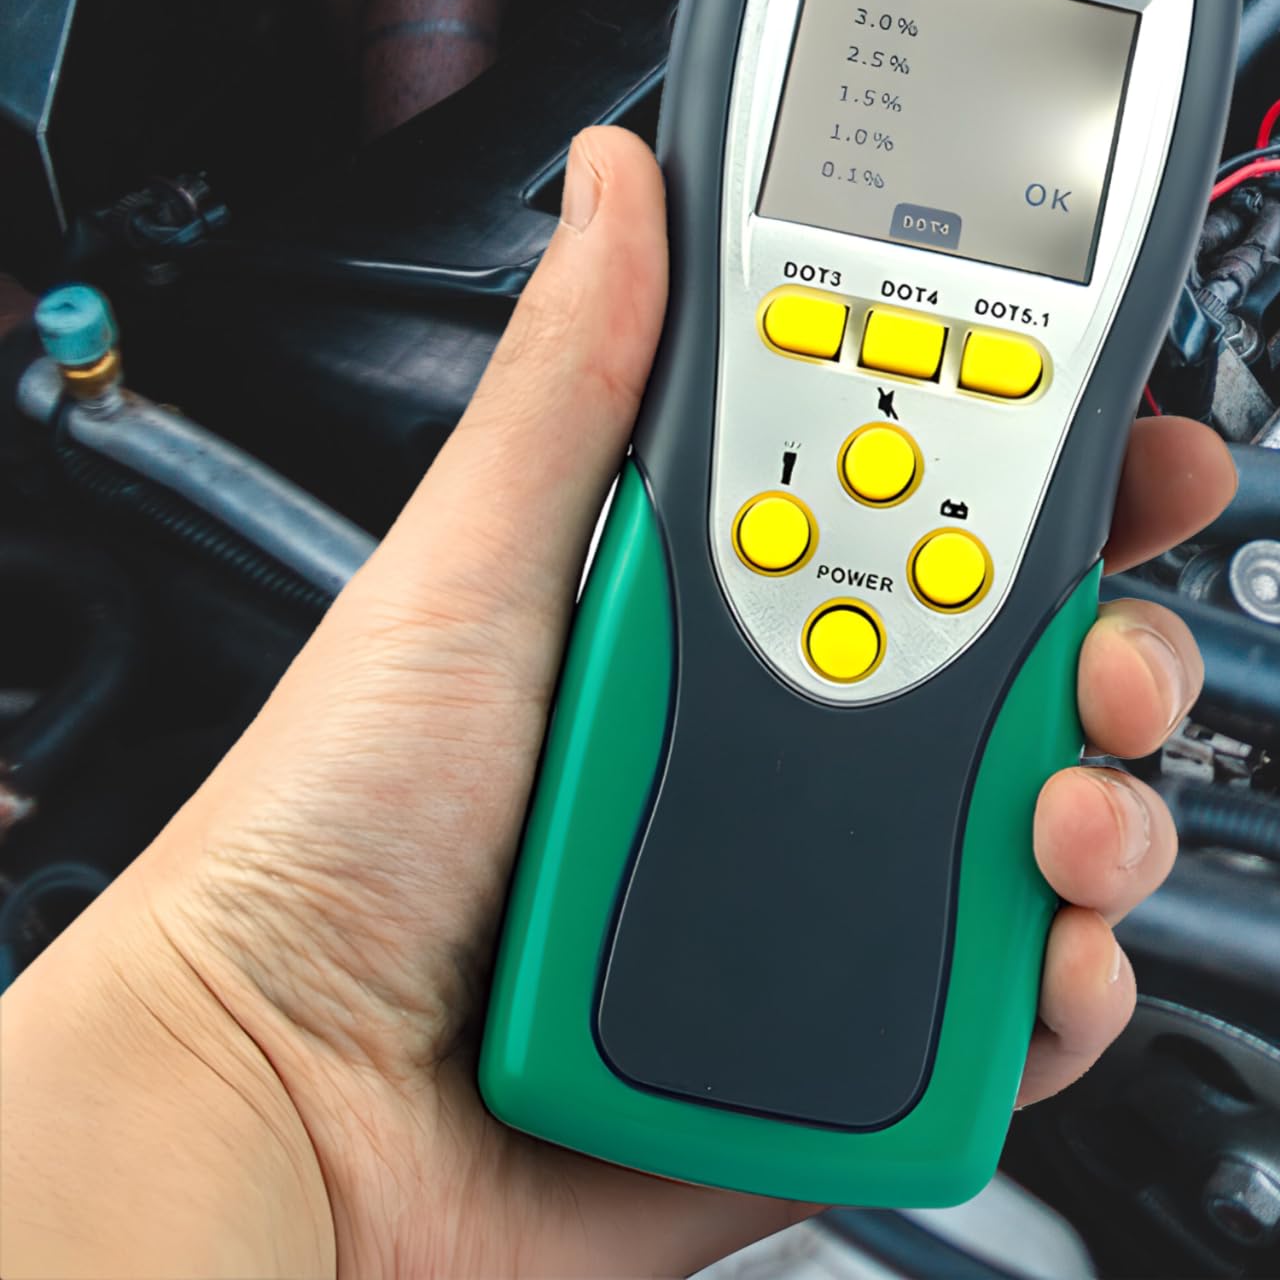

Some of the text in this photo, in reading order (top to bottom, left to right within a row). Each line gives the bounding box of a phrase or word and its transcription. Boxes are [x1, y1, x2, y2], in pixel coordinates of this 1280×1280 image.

[854, 8, 918, 37] 3.0%
[846, 46, 909, 74] 2.5%
[840, 86, 902, 112] 1.5%
[830, 124, 894, 151] 1.0%
[821, 161, 885, 189] 0.1%
[1025, 183, 1072, 212] OK
[783, 261, 842, 287] DOT3
[881, 280, 939, 305] DOT4
[974, 299, 1050, 327] DOT5.1
[816, 564, 894, 593] POWER
